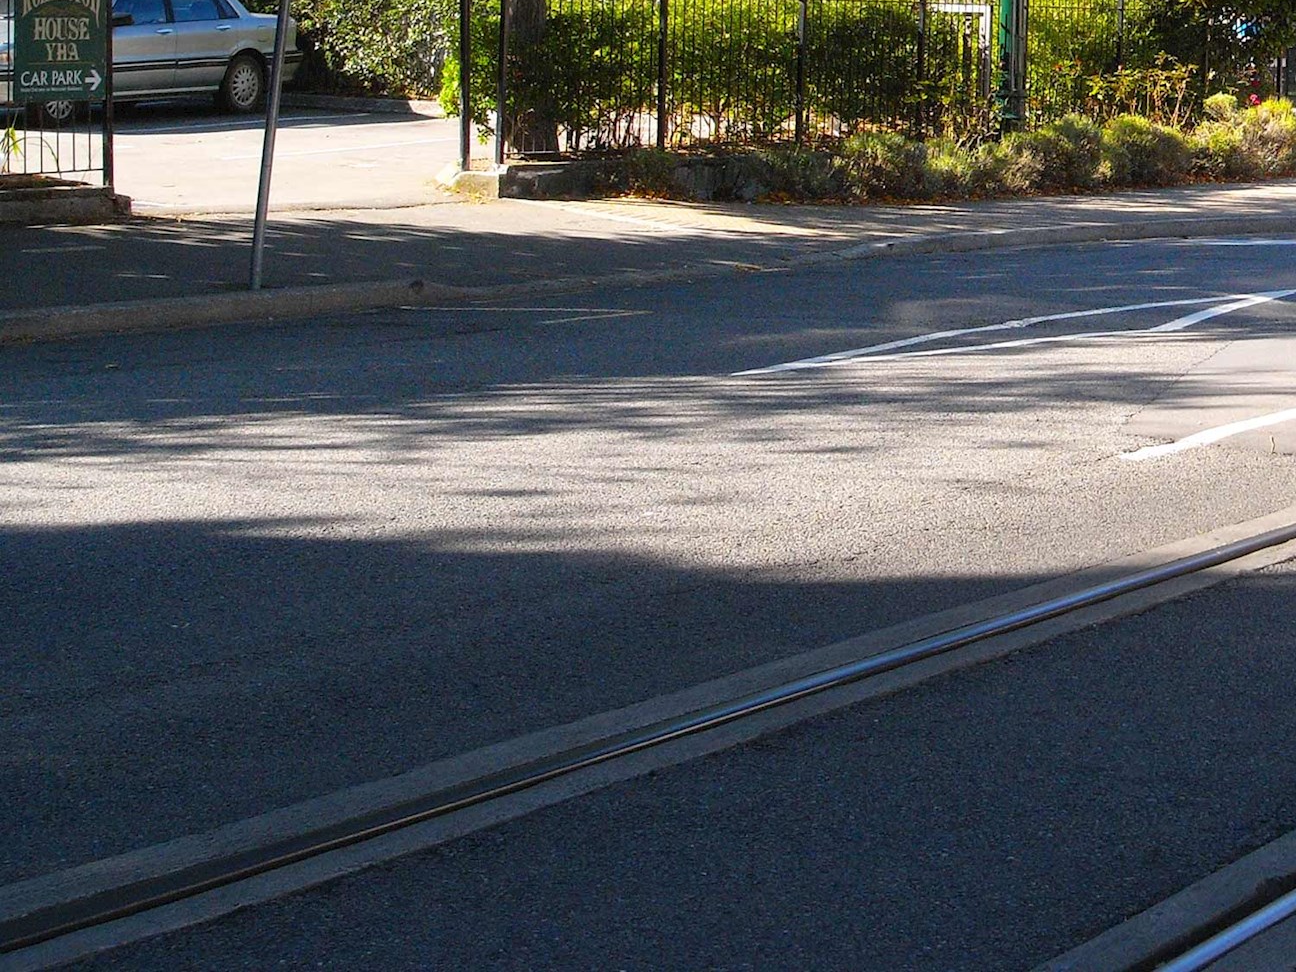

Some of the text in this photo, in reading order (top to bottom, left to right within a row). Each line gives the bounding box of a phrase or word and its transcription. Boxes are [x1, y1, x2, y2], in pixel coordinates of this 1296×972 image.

[34, 17, 90, 41] HOUSE
[45, 42, 80, 62] YHA
[20, 69, 83, 87] CAR PARK
